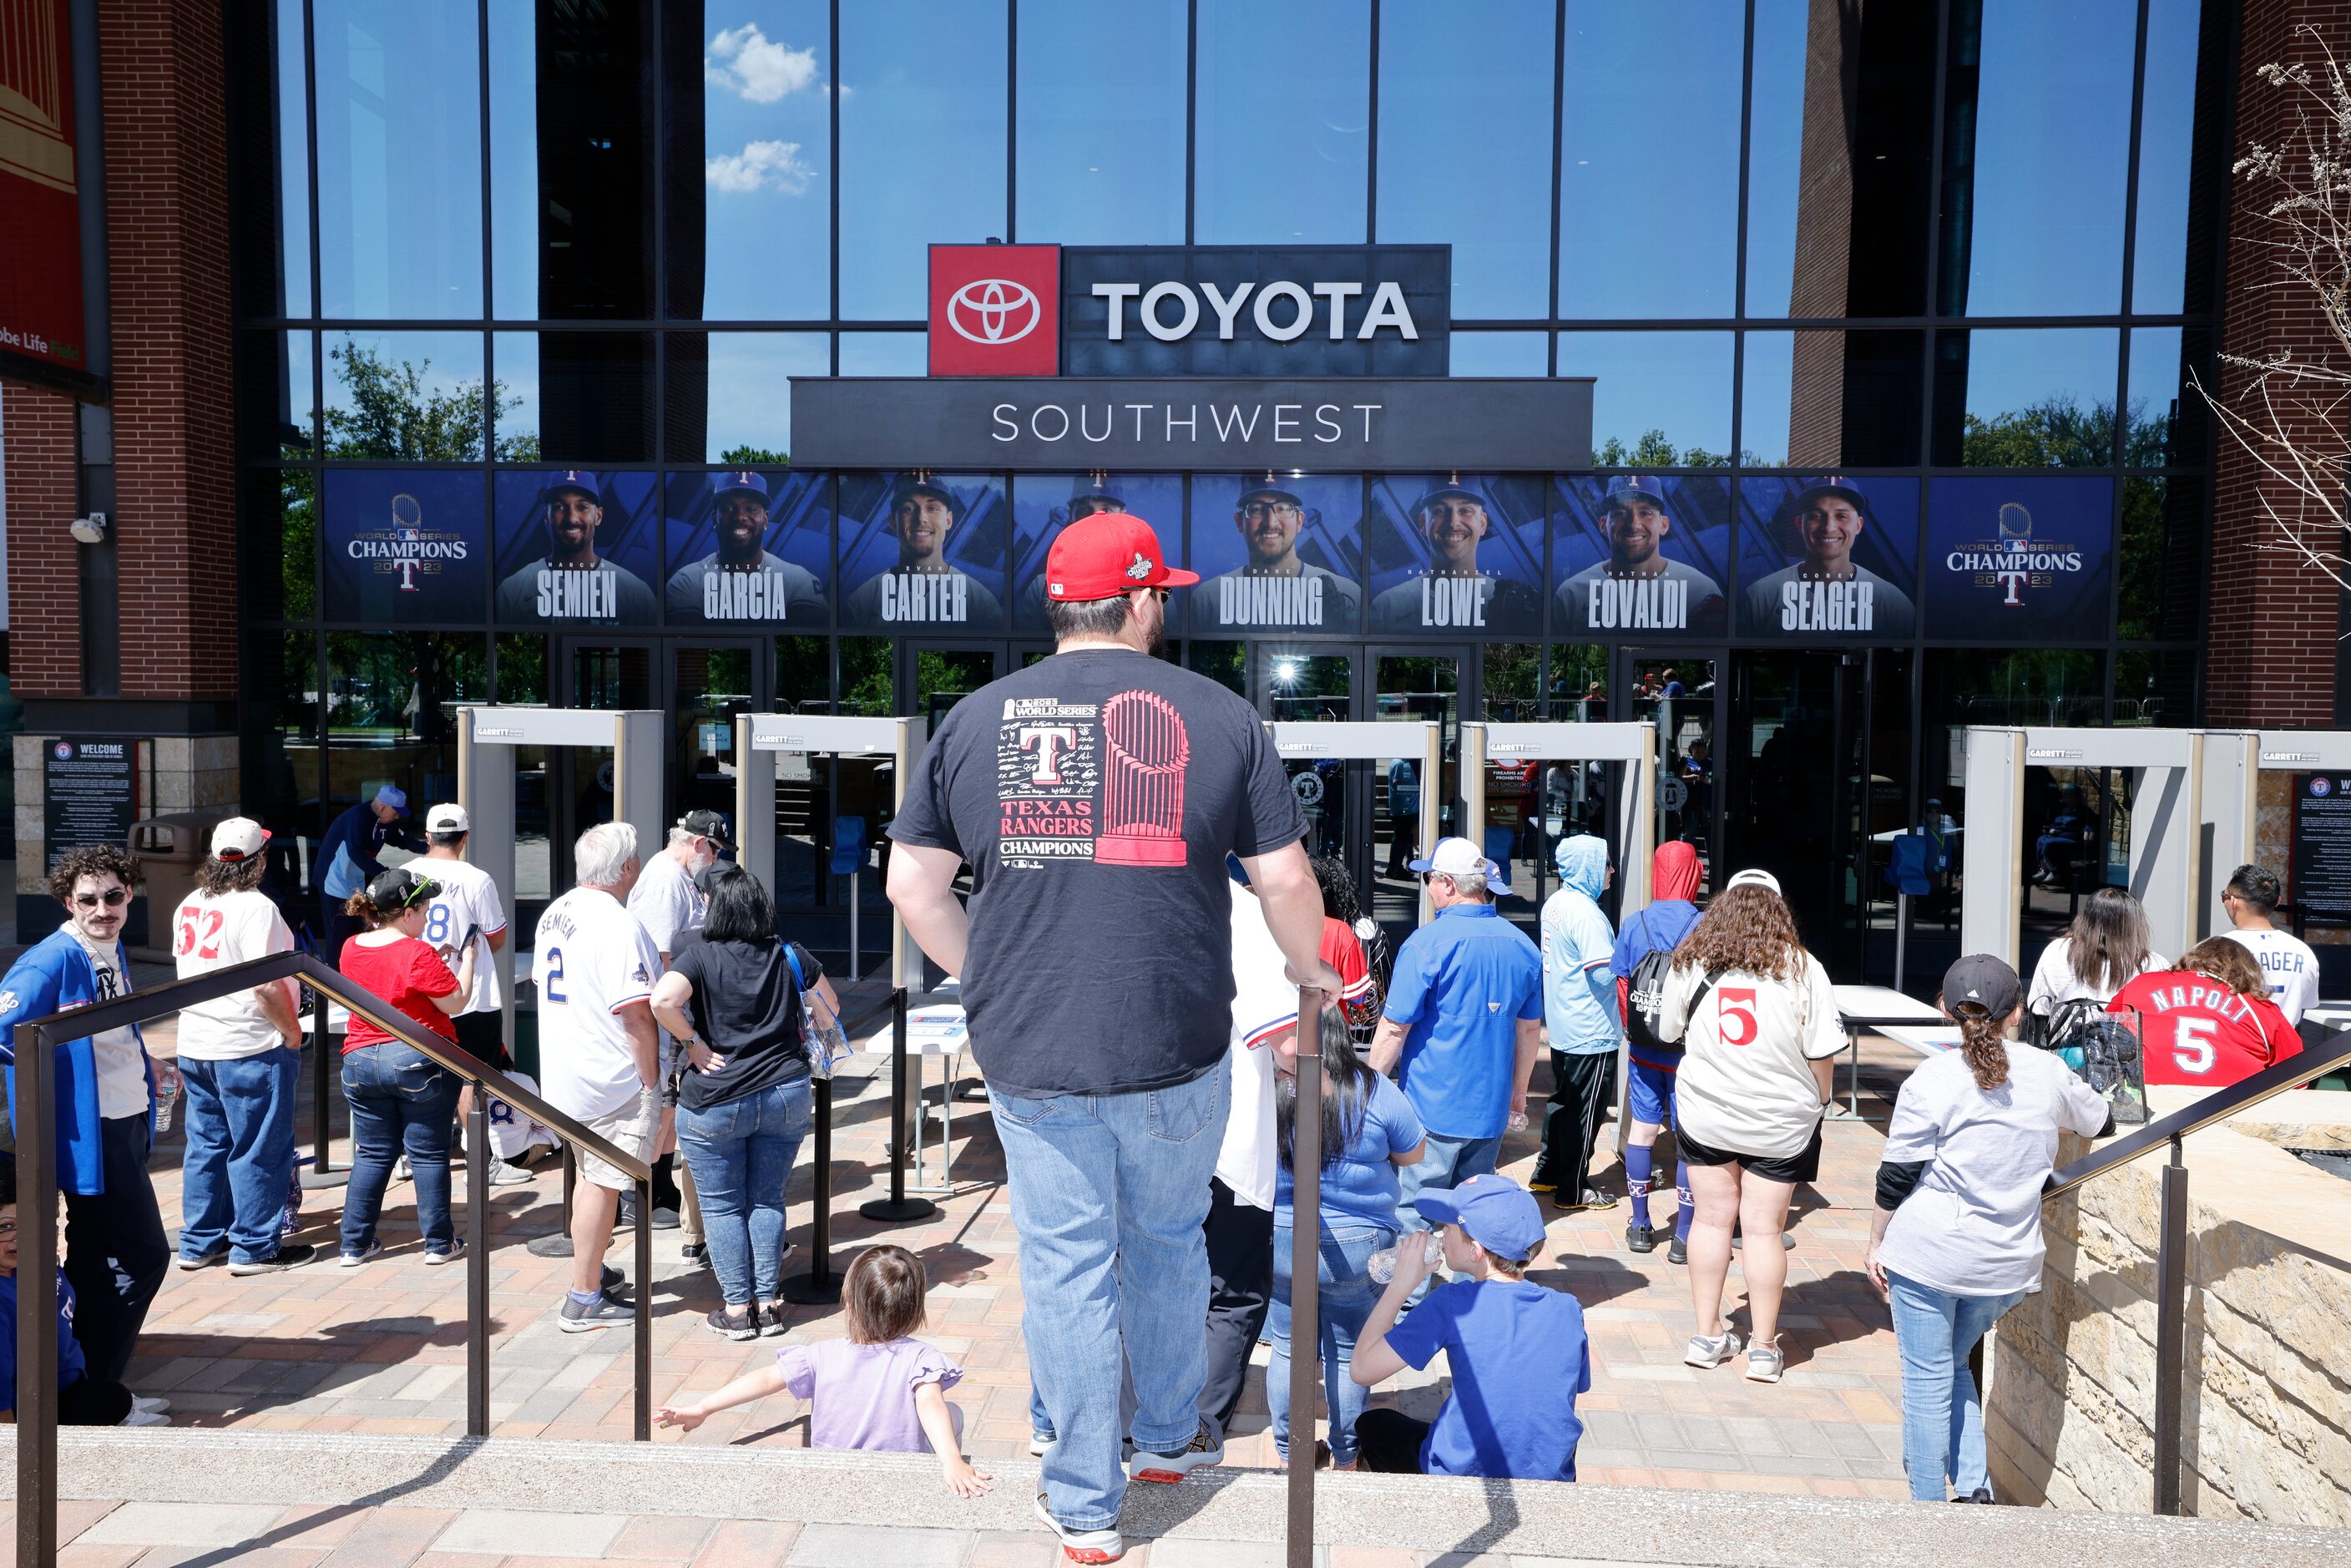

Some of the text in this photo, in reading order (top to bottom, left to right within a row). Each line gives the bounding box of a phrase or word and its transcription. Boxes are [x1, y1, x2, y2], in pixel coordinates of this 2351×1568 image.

[1092, 281, 1419, 341] TOYOTA
[23, 332, 48, 353] Life
[992, 403, 1383, 443] SOUTHWEST
[348, 540, 467, 559] CHAMPIONS
[1947, 552, 2082, 571] CHAMPIONS
[1954, 544, 2075, 552] WORLD SERIES
[374, 559, 442, 591] 20 T 23
[1974, 571, 2052, 606] 20 T 23
[537, 569, 616, 618] SEMIEN
[704, 567, 786, 620] GARCÍA
[882, 573, 967, 621] CARTER
[1220, 576, 1323, 625] DUNNING
[1422, 578, 1486, 627] LOWE
[1588, 579, 1687, 629] EOVALDI
[1782, 581, 1873, 631] SEAGER
[1015, 706, 1097, 716] WORLD SERIES
[80, 744, 124, 754] WELCOME
[1020, 727, 1077, 785] T
[1490, 743, 1525, 751] GARRETT
[2030, 750, 2066, 758] GARRETT
[2263, 752, 2302, 761] GARRETT
[1001, 800, 1092, 816] TEXAS
[379, 828, 387, 840] T
[1000, 817, 1093, 836] RANGERS
[1000, 842, 1094, 856] CHAMPIONS
[177, 906, 224, 959] 52
[542, 913, 577, 942] SEMIEN
[547, 947, 569, 1005] 2
[2259, 952, 2304, 974] AGER
[1718, 987, 1758, 1046] 5
[2151, 985, 2252, 1024] NAPOLI
[2172, 1016, 2219, 1075] 5
